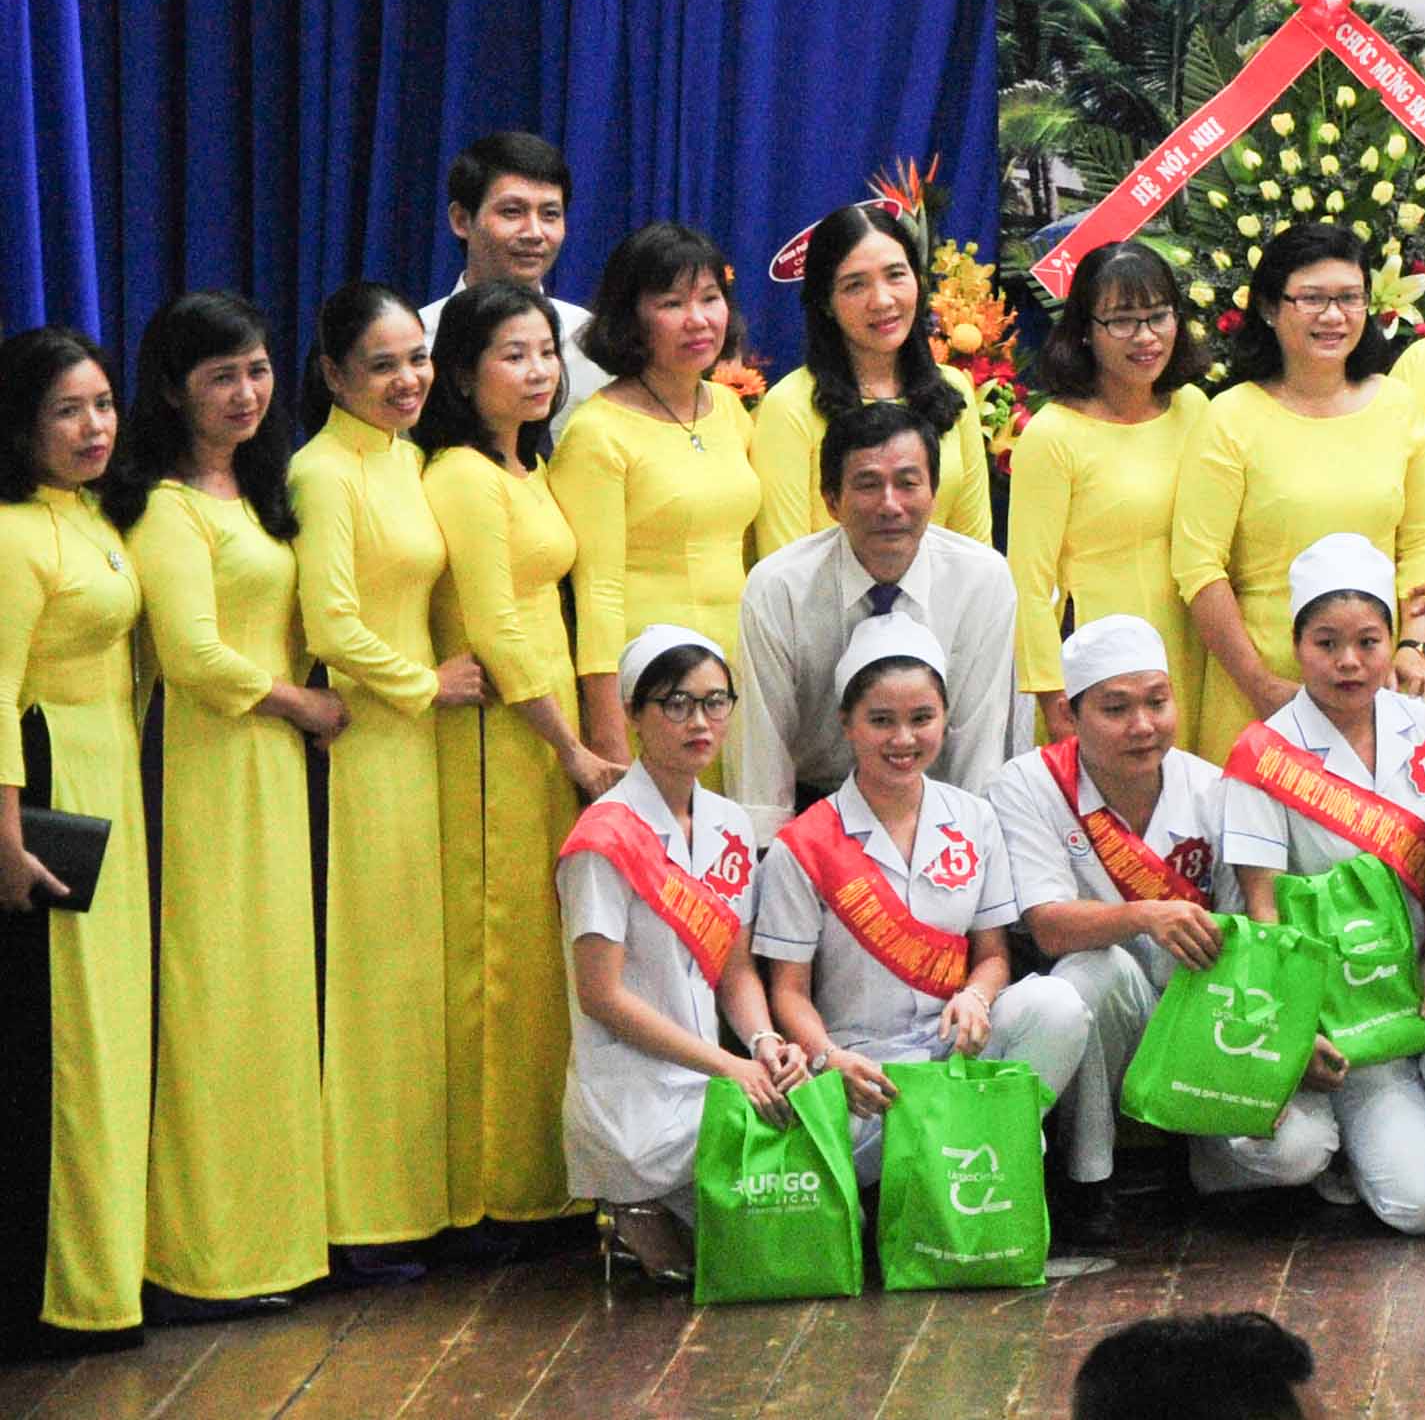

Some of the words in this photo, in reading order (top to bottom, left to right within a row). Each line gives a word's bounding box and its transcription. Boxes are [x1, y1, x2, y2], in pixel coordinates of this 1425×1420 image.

[1331, 18, 1380, 67] CHÚC
[1128, 173, 1163, 208] HỆ
[1187, 114, 1226, 152] NHI
[710, 852, 743, 884] 16
[1173, 849, 1202, 879] 13
